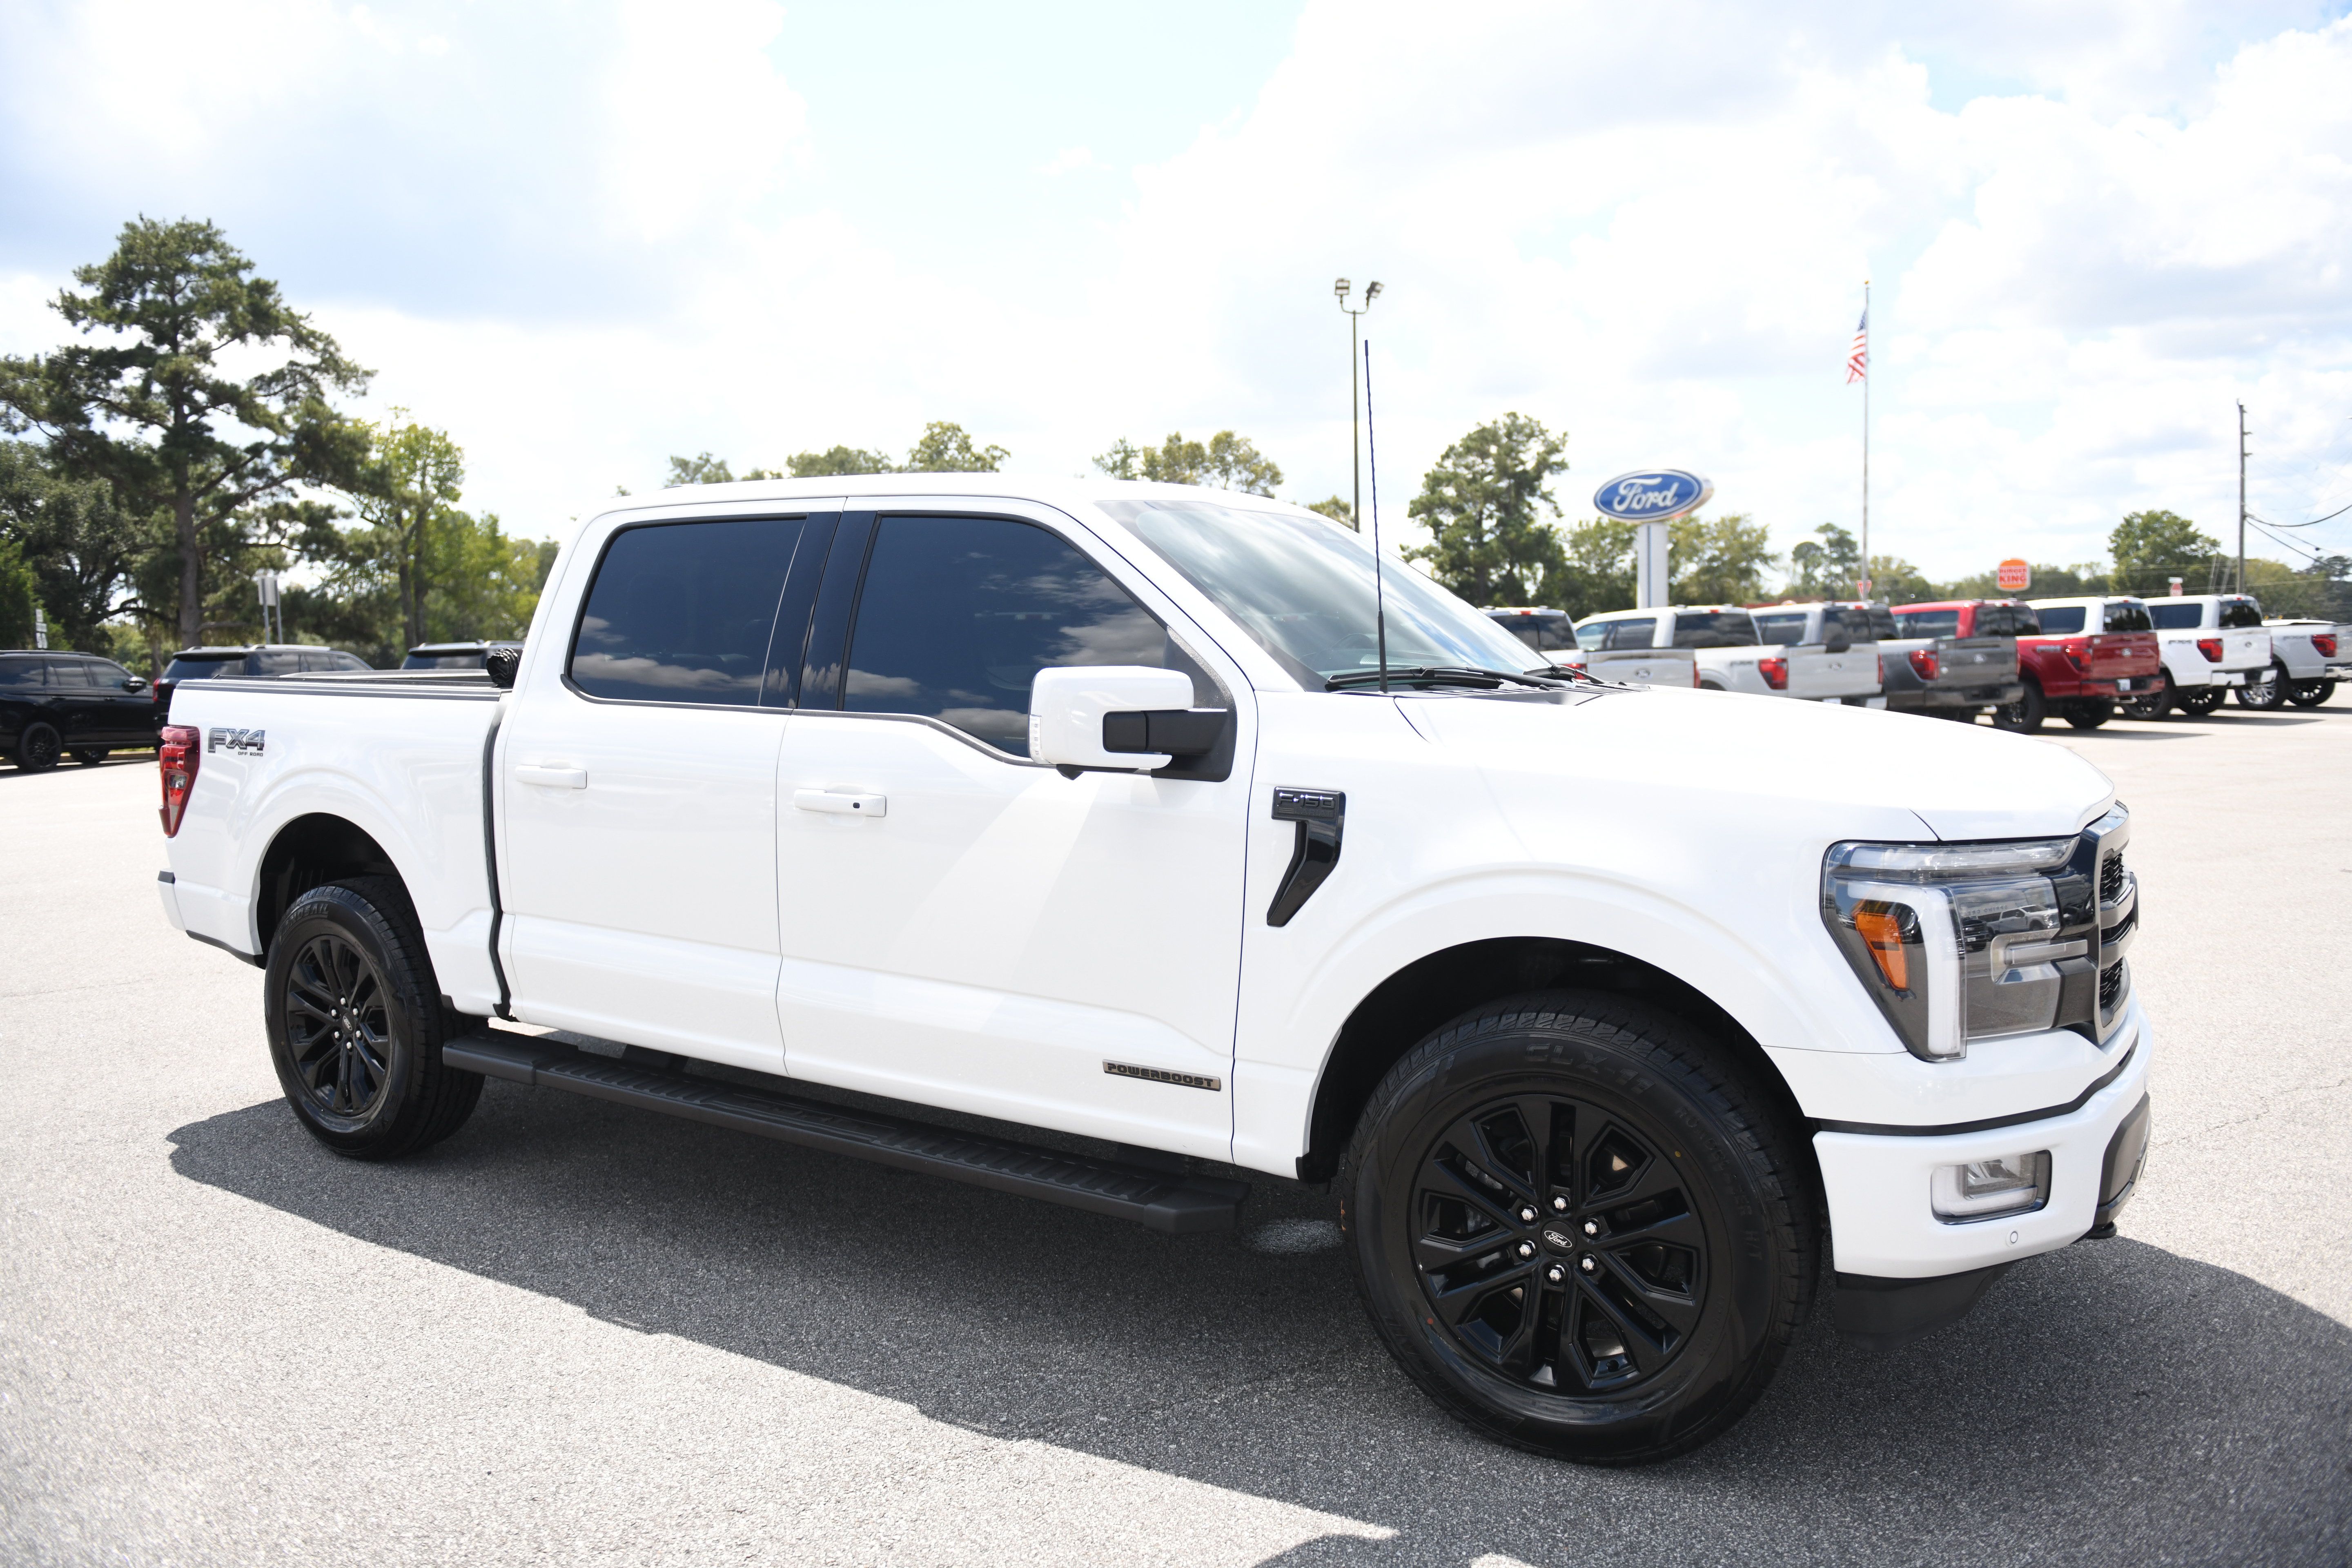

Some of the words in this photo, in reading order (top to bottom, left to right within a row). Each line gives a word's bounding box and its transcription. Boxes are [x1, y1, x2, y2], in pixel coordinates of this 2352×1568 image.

[1613, 477, 1679, 512] Ford
[208, 728, 265, 753] FX4
[1277, 793, 1335, 808] F-150
[1107, 1062, 1213, 1087] POWERBOOST
[1525, 1043, 1655, 1095] CLX-11
[1548, 1233, 1567, 1246] Ford
